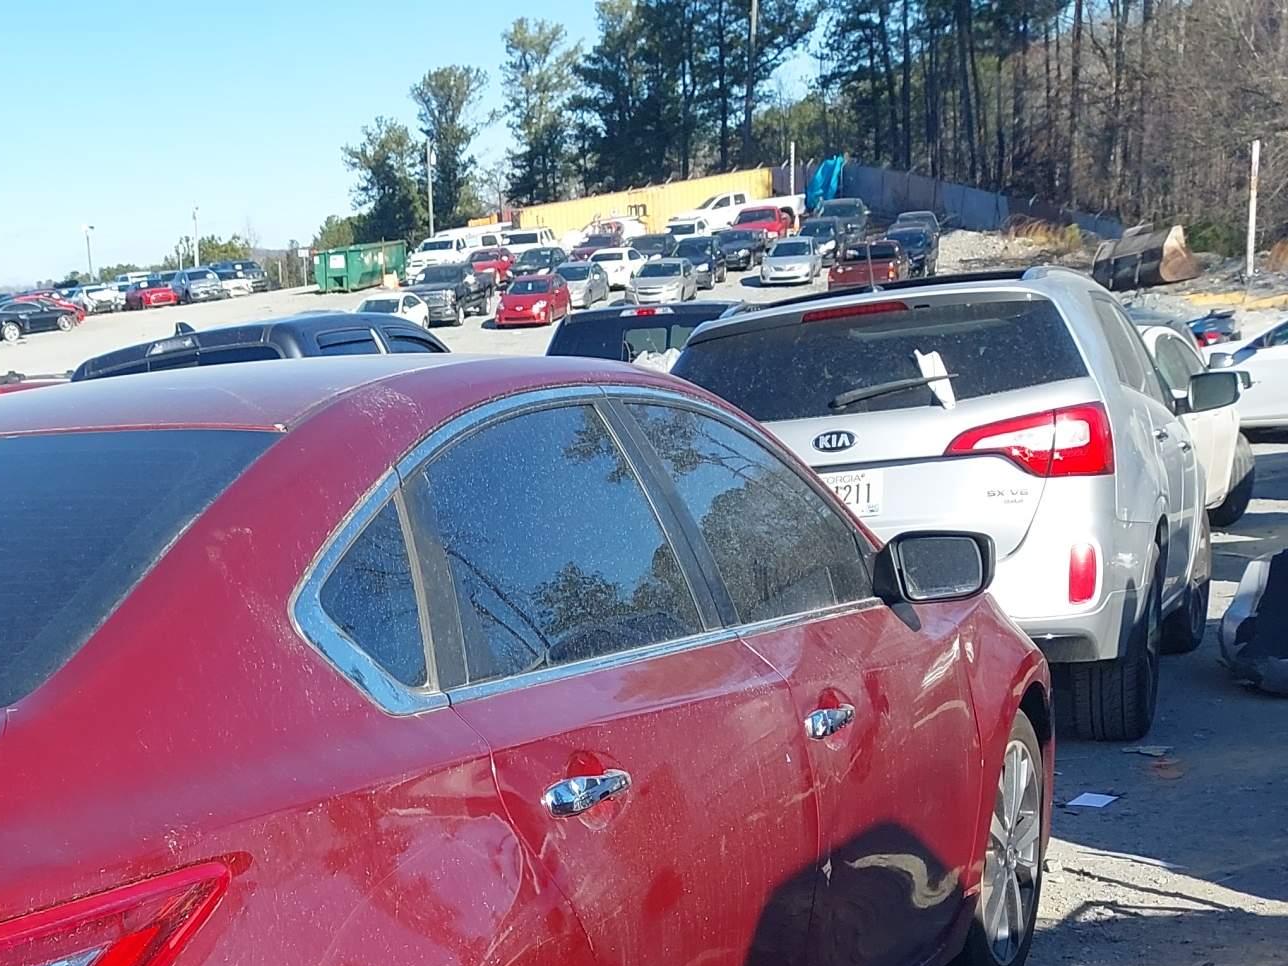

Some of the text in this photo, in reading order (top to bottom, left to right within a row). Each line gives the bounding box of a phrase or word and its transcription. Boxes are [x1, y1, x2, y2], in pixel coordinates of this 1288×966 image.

[818, 433, 850, 449] KIA
[823, 473, 862, 485] ORGIA
[986, 489, 1005, 497] SX
